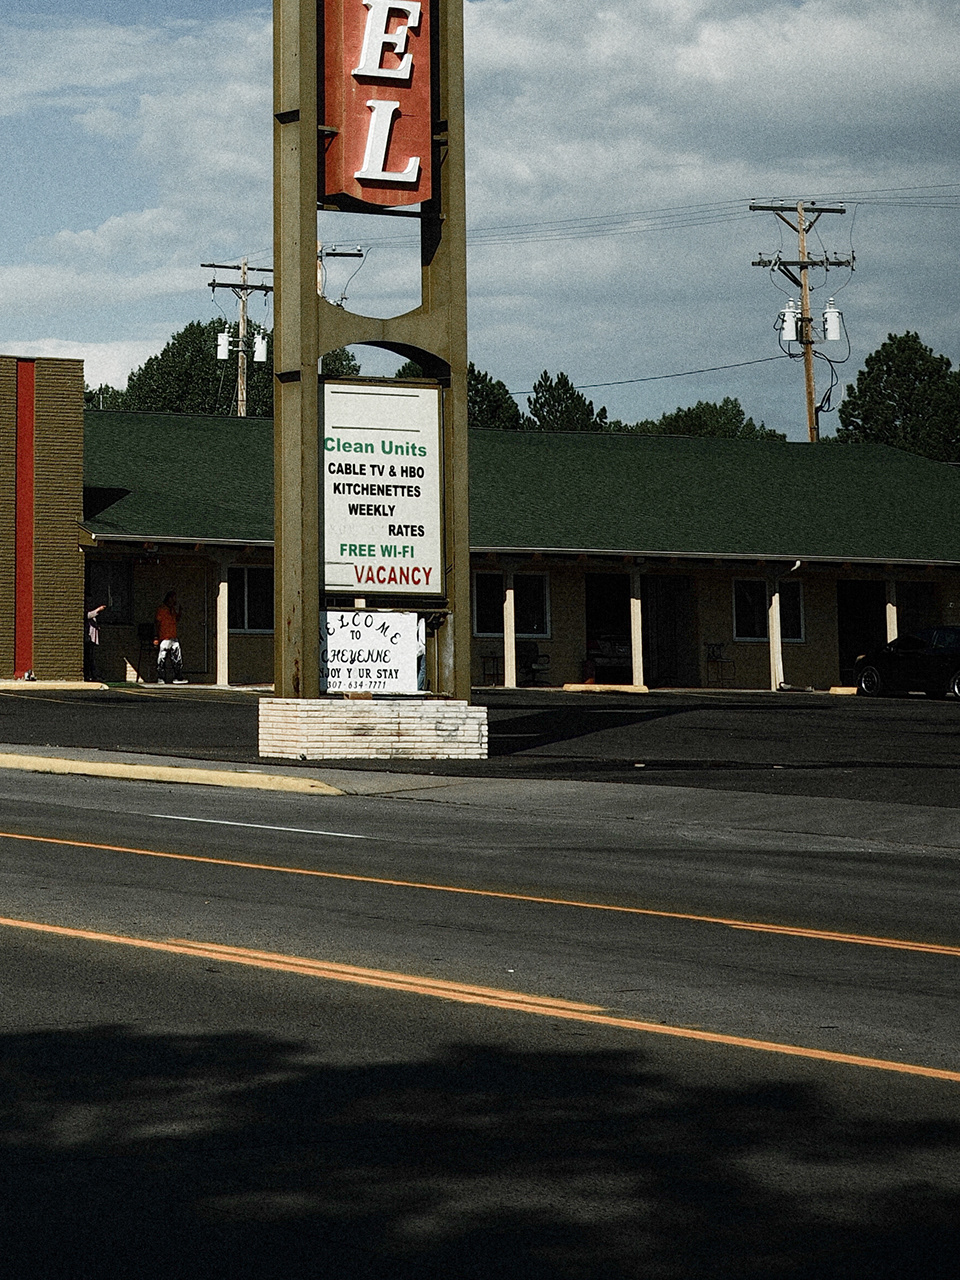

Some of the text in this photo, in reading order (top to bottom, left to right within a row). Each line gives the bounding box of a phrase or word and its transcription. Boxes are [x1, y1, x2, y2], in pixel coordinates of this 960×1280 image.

[324, 437, 427, 457] Clean Units
[328, 462, 425, 478] CABLE TV & HBO
[333, 482, 421, 498] KITCHENETTES
[348, 503, 396, 516] WEEKLY
[388, 524, 425, 537] RATES
[340, 543, 414, 558] FREE WI-FI
[354, 565, 432, 585] VACANCY
[350, 630, 361, 640] TO
[321, 649, 391, 664] CHEYENNE
[376, 669, 399, 679] STAY
